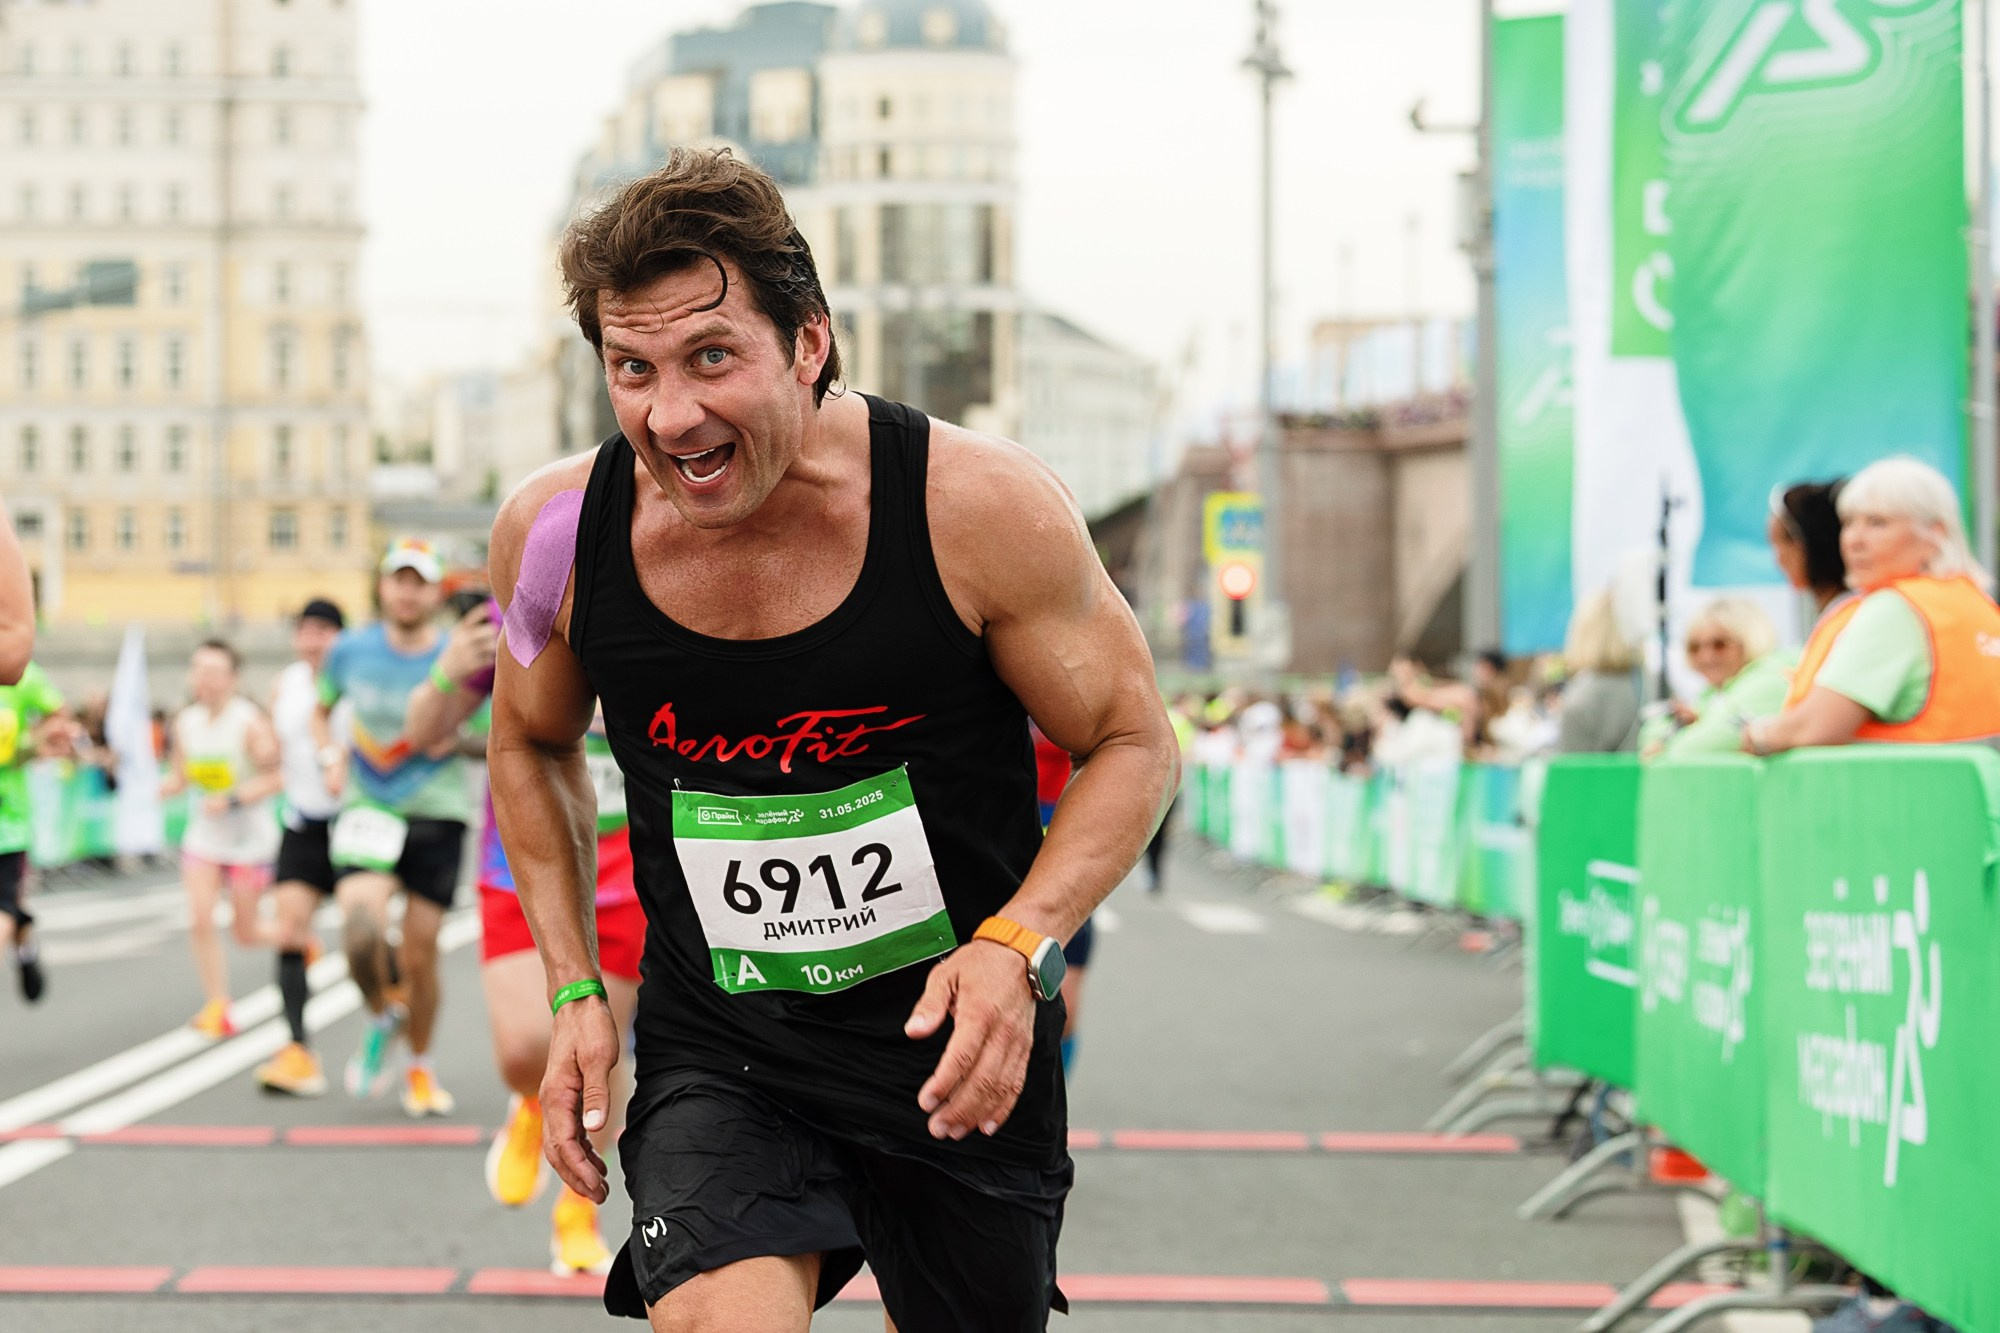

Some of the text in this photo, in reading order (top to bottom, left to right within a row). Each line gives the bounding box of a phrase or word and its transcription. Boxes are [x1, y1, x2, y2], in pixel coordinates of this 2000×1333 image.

[648, 702, 927, 774] AeroFit
[711, 811, 736, 821] Прайм
[756, 809, 788, 818] зелёный
[818, 789, 884, 819] 31.05.2025
[754, 815, 788, 826] марафон
[722, 842, 903, 915] 6912
[763, 906, 878, 941] ДМИТРИЙ
[800, 963, 865, 986] 10 км
